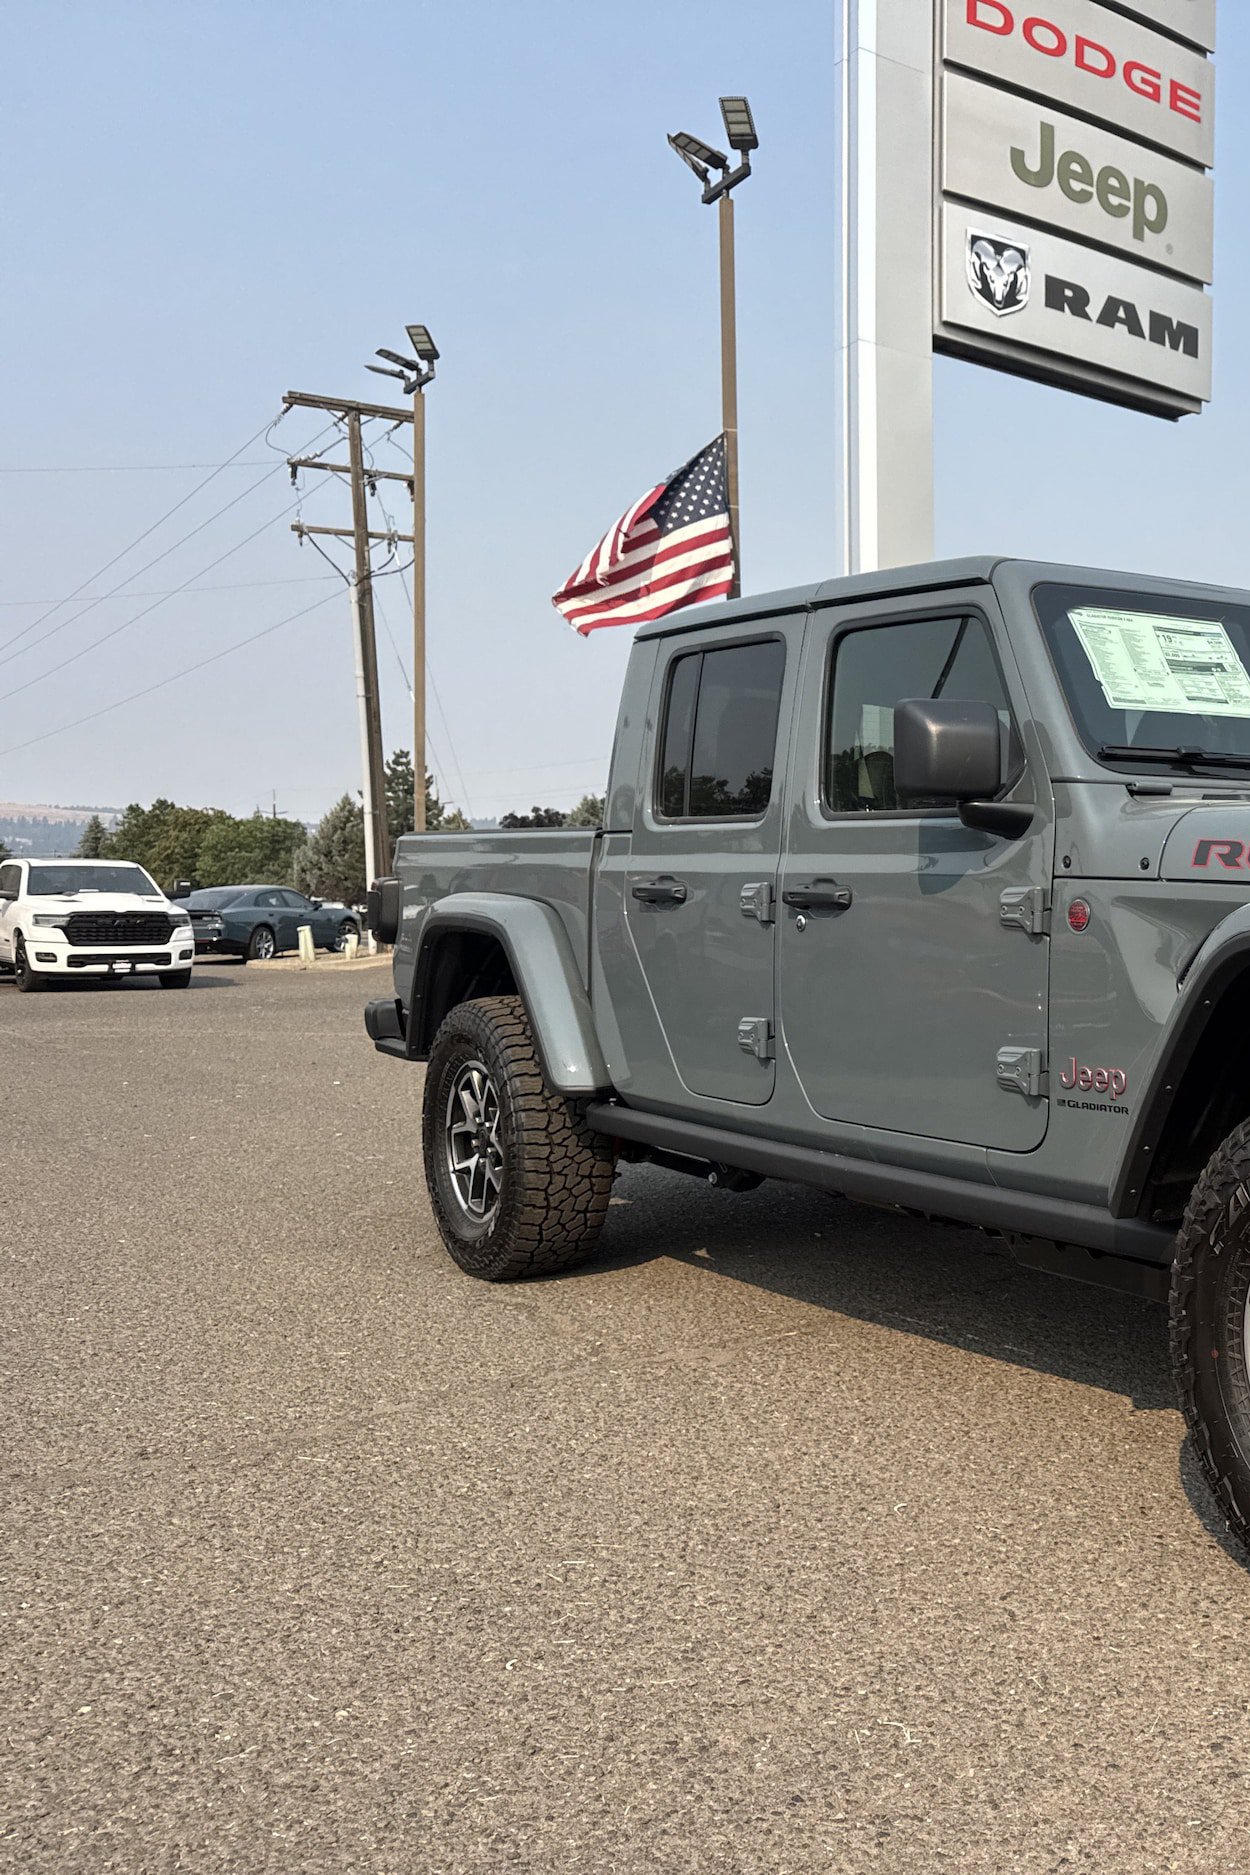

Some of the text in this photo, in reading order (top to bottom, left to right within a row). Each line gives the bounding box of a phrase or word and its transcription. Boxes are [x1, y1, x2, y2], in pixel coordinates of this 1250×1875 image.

[965, 0, 1202, 124] DODGE
[1010, 121, 1169, 242] Jeep
[1044, 274, 1199, 359] RAM
[1059, 1056, 1127, 1100] Jeep
[1067, 1099, 1129, 1115] GLADIATOR
